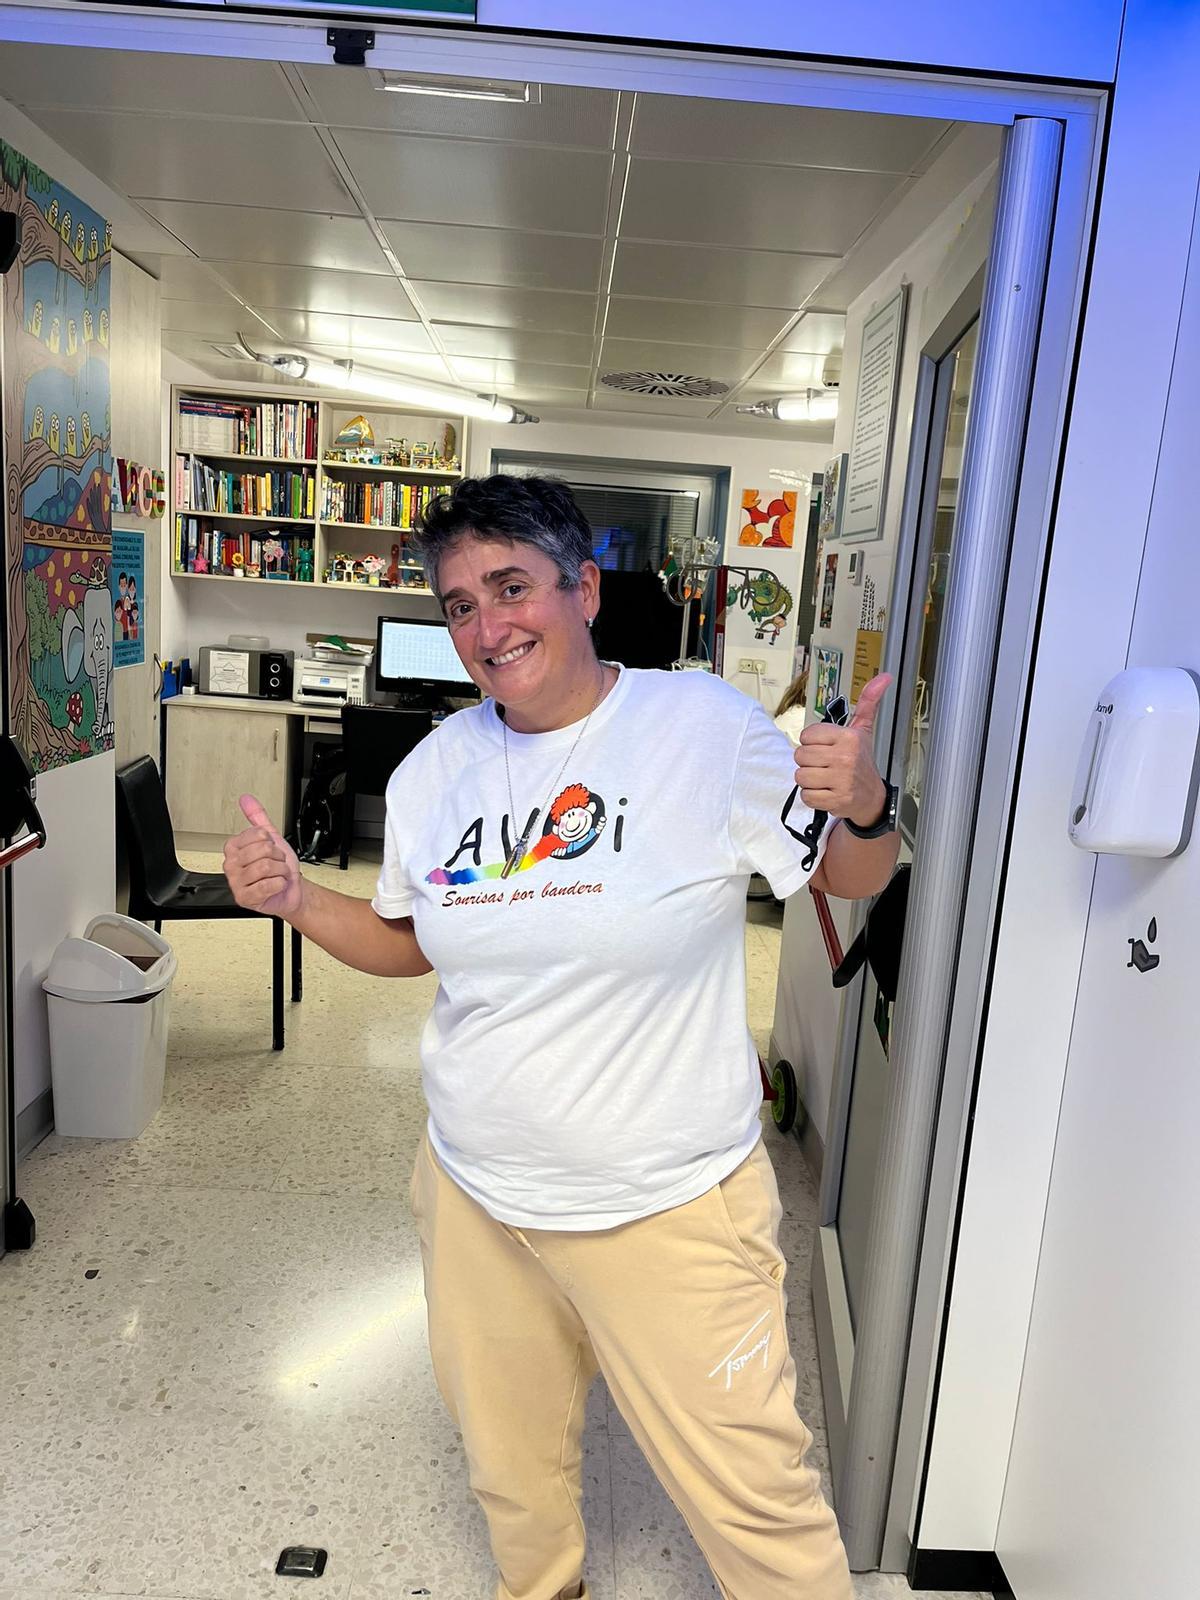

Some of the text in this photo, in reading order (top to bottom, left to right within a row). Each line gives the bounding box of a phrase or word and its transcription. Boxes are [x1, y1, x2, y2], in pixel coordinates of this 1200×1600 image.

[442, 881, 604, 908] Sonrisas por bandera
